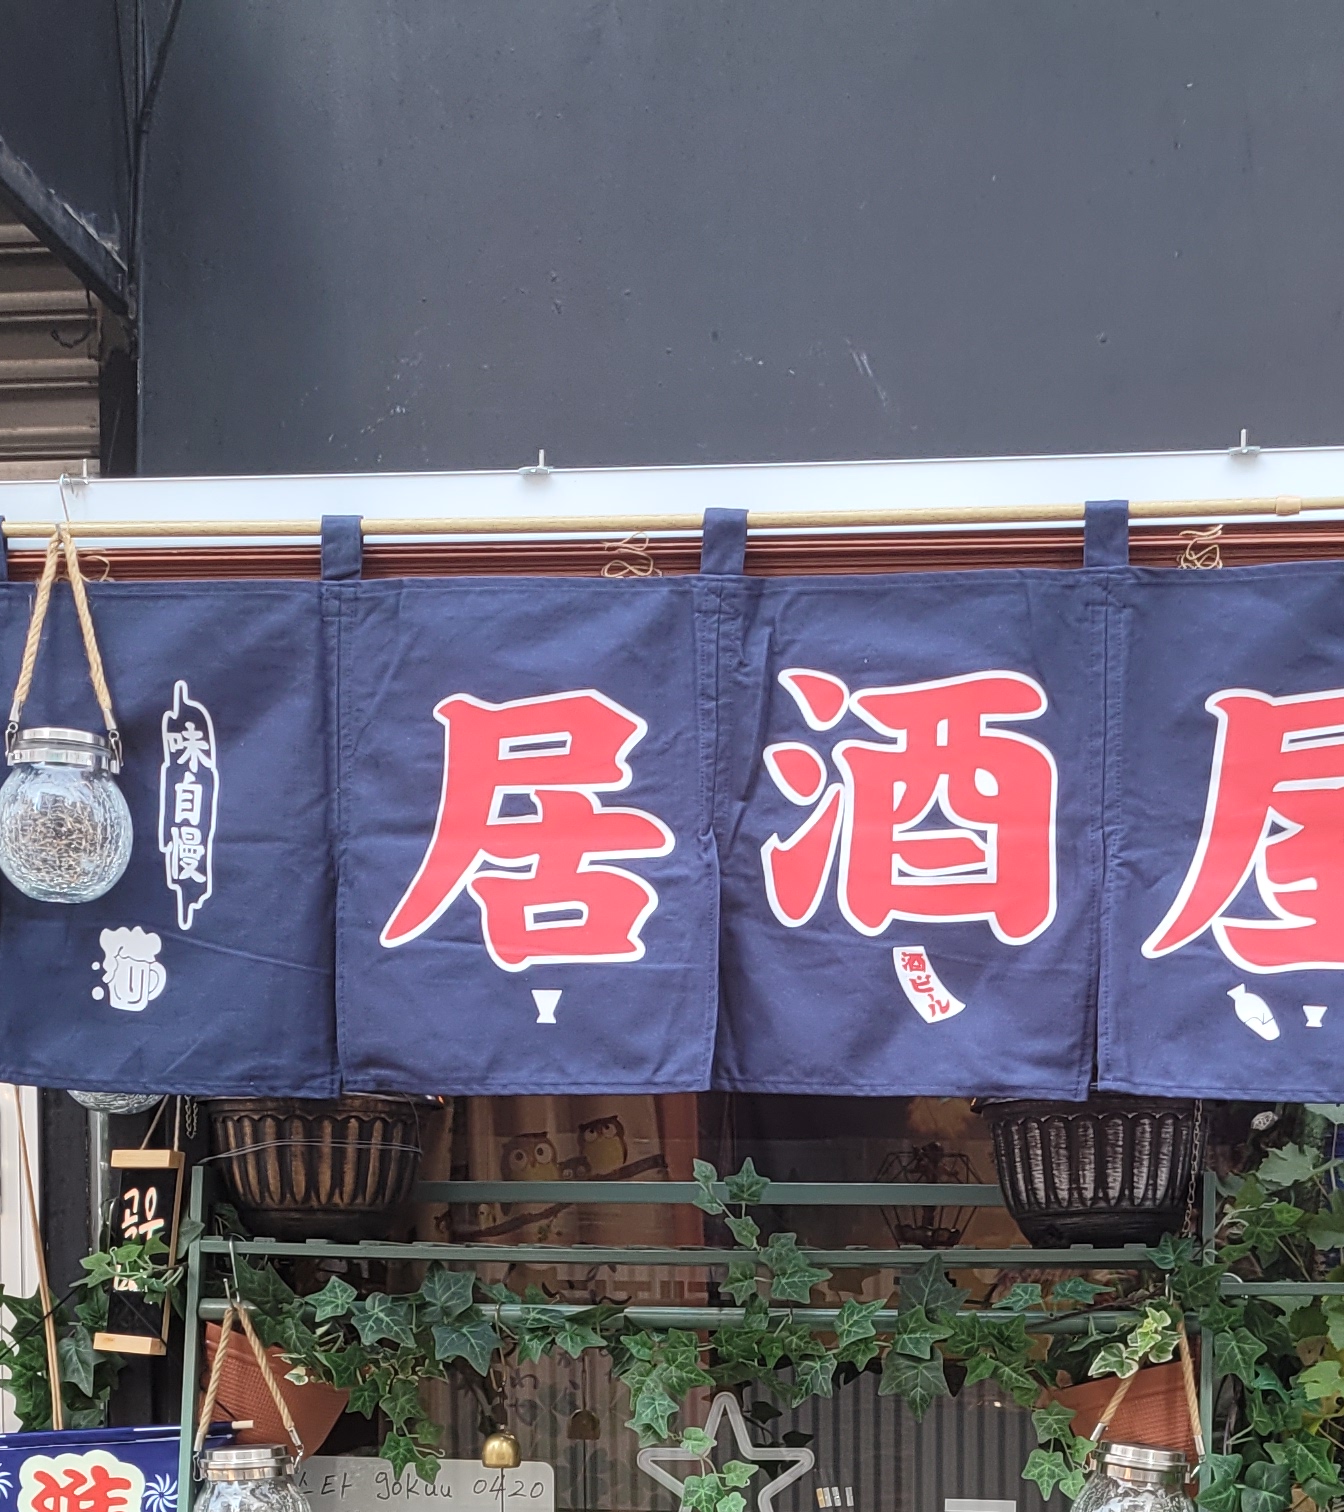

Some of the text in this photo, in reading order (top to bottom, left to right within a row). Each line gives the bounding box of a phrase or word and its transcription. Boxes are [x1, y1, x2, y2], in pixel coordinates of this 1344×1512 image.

[167, 723, 210, 883] 味自慢
[901, 951, 950, 1018] 酒ビール
[473, 1475, 545, 1500] 0420
